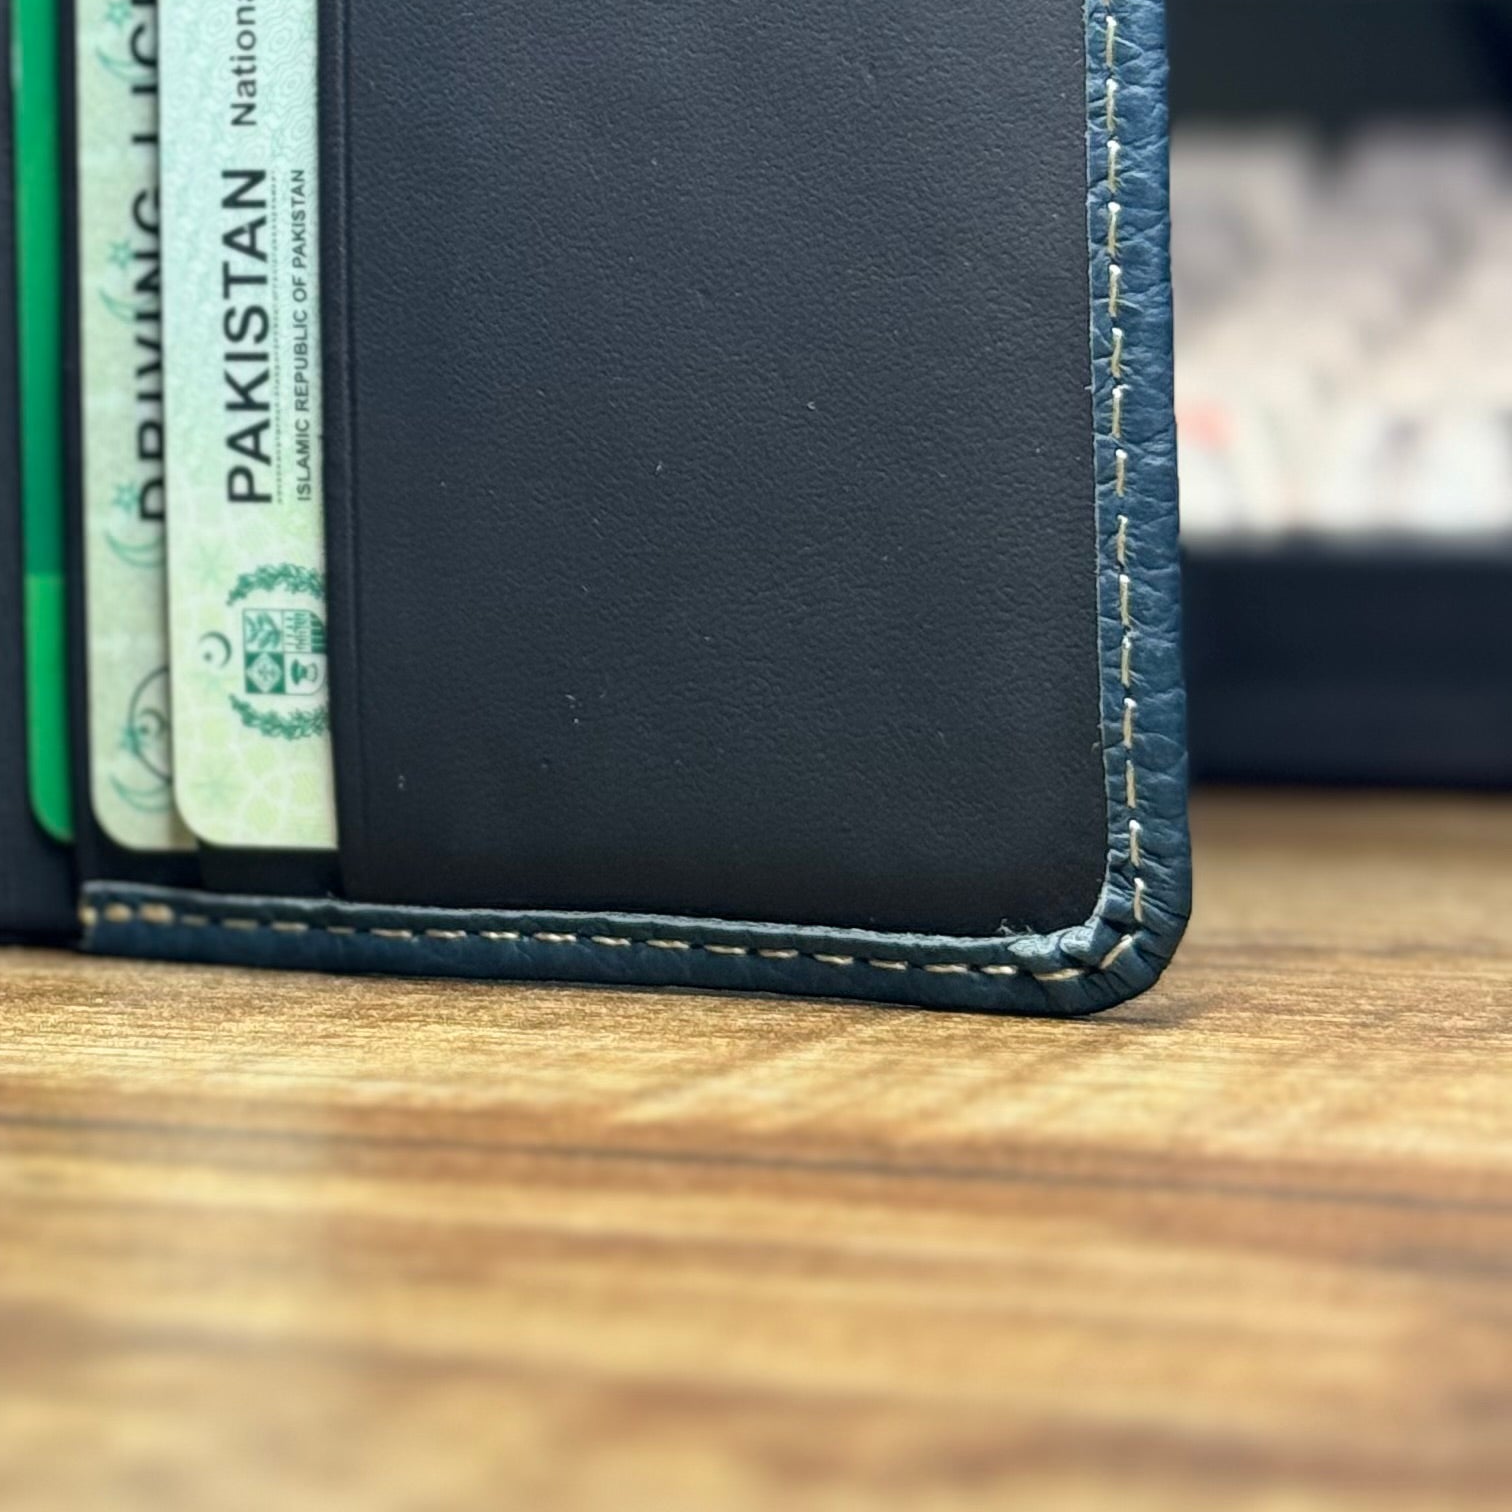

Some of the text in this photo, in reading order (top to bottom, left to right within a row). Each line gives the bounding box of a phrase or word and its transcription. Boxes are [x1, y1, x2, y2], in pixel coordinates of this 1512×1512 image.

[221, 169, 272, 504] PAKISTAN
[290, 169, 311, 502] ISLAMIC REPUBLIC OF PAKISTAN
